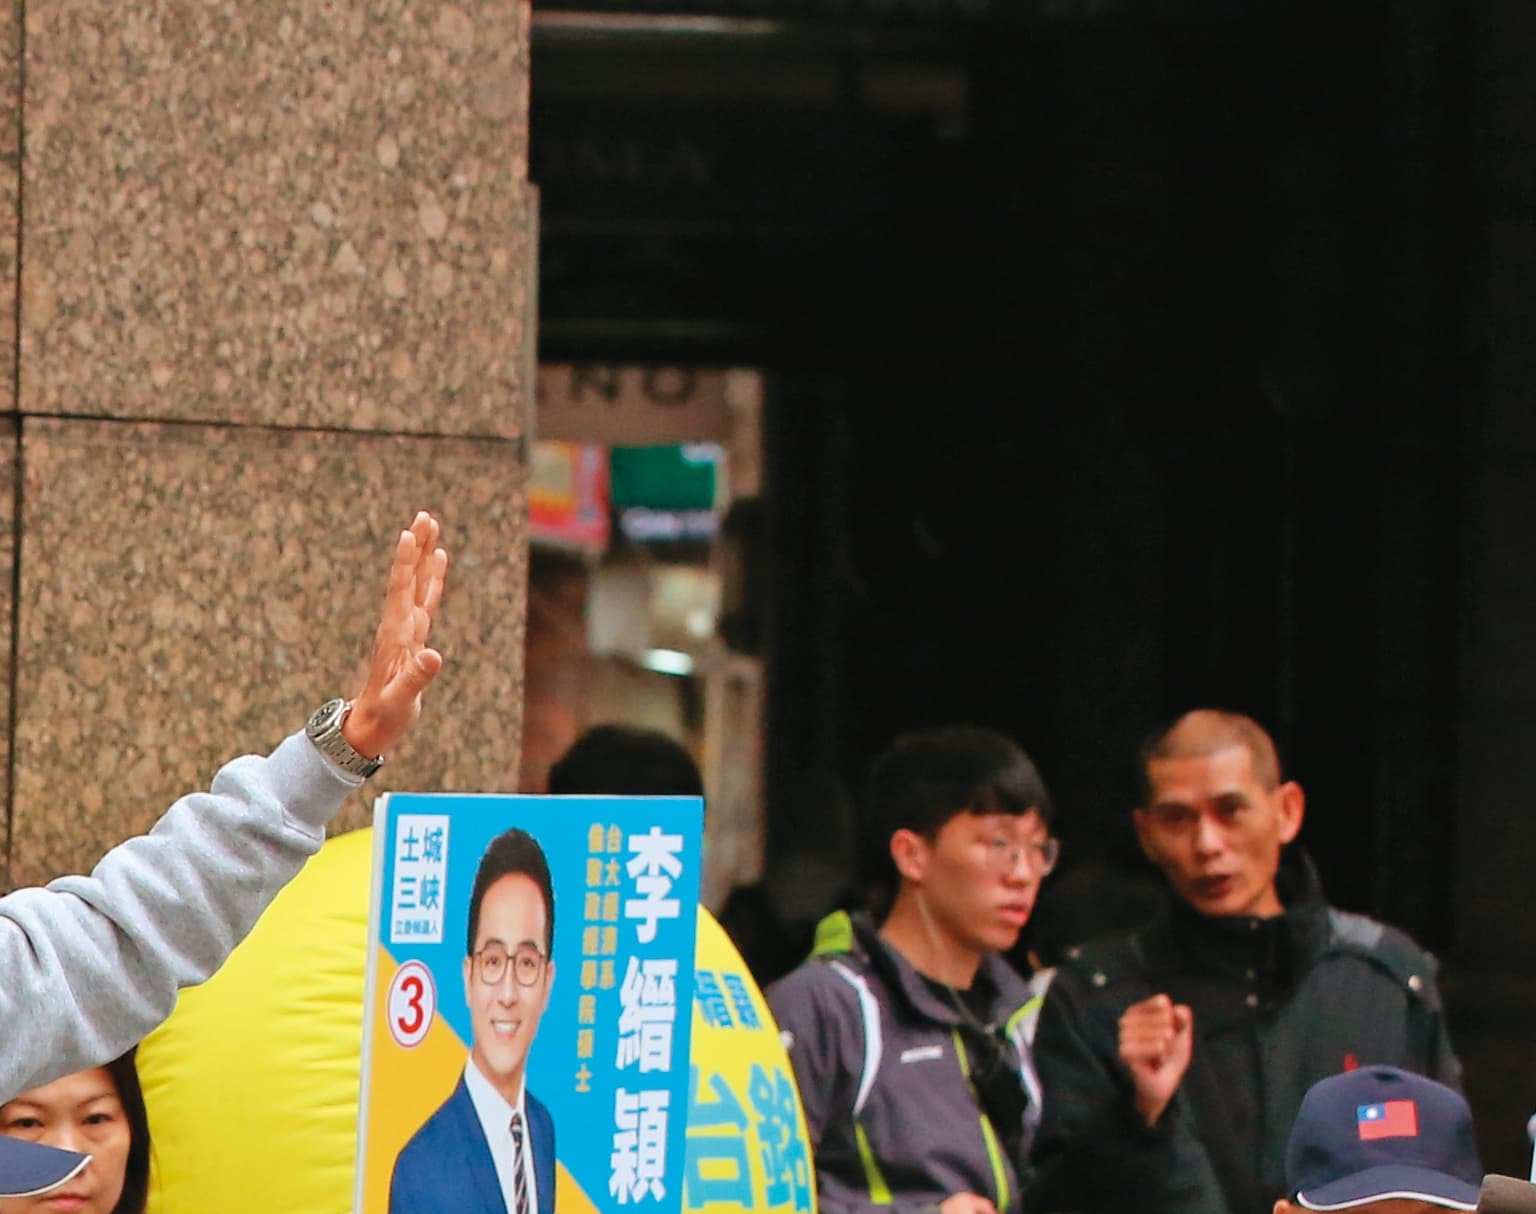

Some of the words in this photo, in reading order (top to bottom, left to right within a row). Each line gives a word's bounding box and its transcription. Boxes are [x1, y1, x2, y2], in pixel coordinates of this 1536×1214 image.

[400, 826, 444, 863] 土城
[397, 873, 441, 911] 三峽
[397, 976, 425, 1035] 3
[608, 826, 684, 1205] 李縉穎
